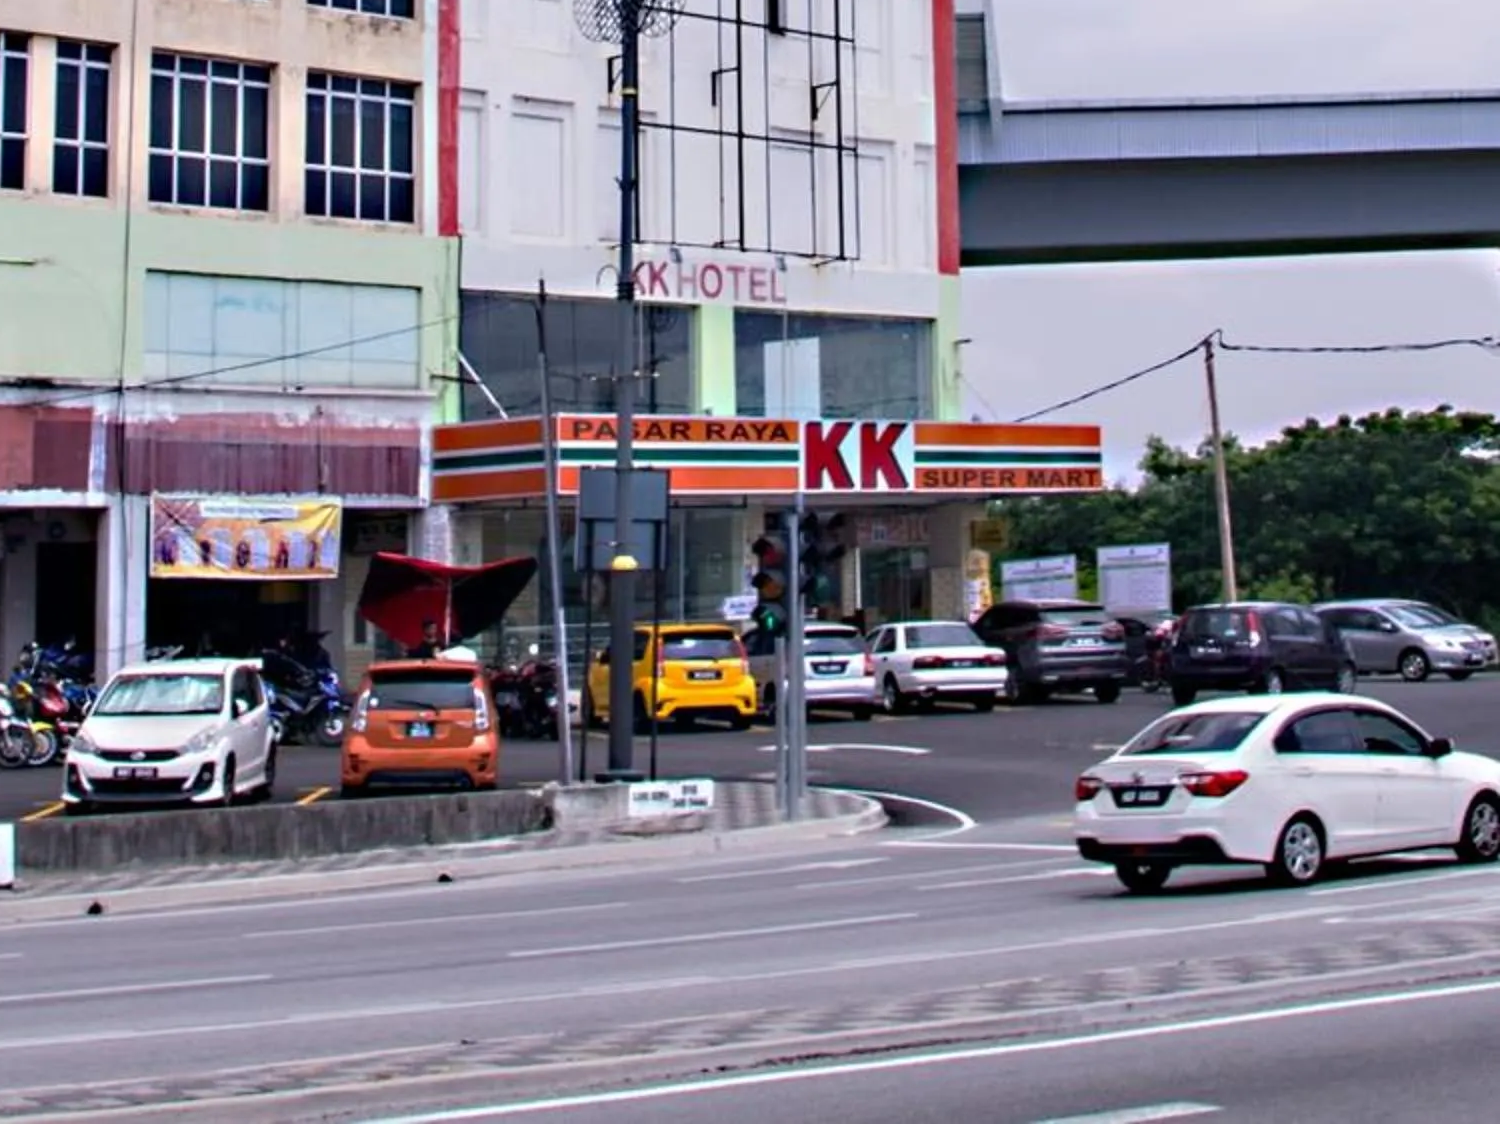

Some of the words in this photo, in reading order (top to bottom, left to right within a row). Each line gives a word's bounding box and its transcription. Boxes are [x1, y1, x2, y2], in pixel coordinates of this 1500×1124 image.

[677, 262, 787, 303] HOTEL
[705, 422, 790, 441] RAYA
[804, 421, 909, 490] KK
[922, 468, 1014, 488] SUPER
[1026, 469, 1099, 488] MART
